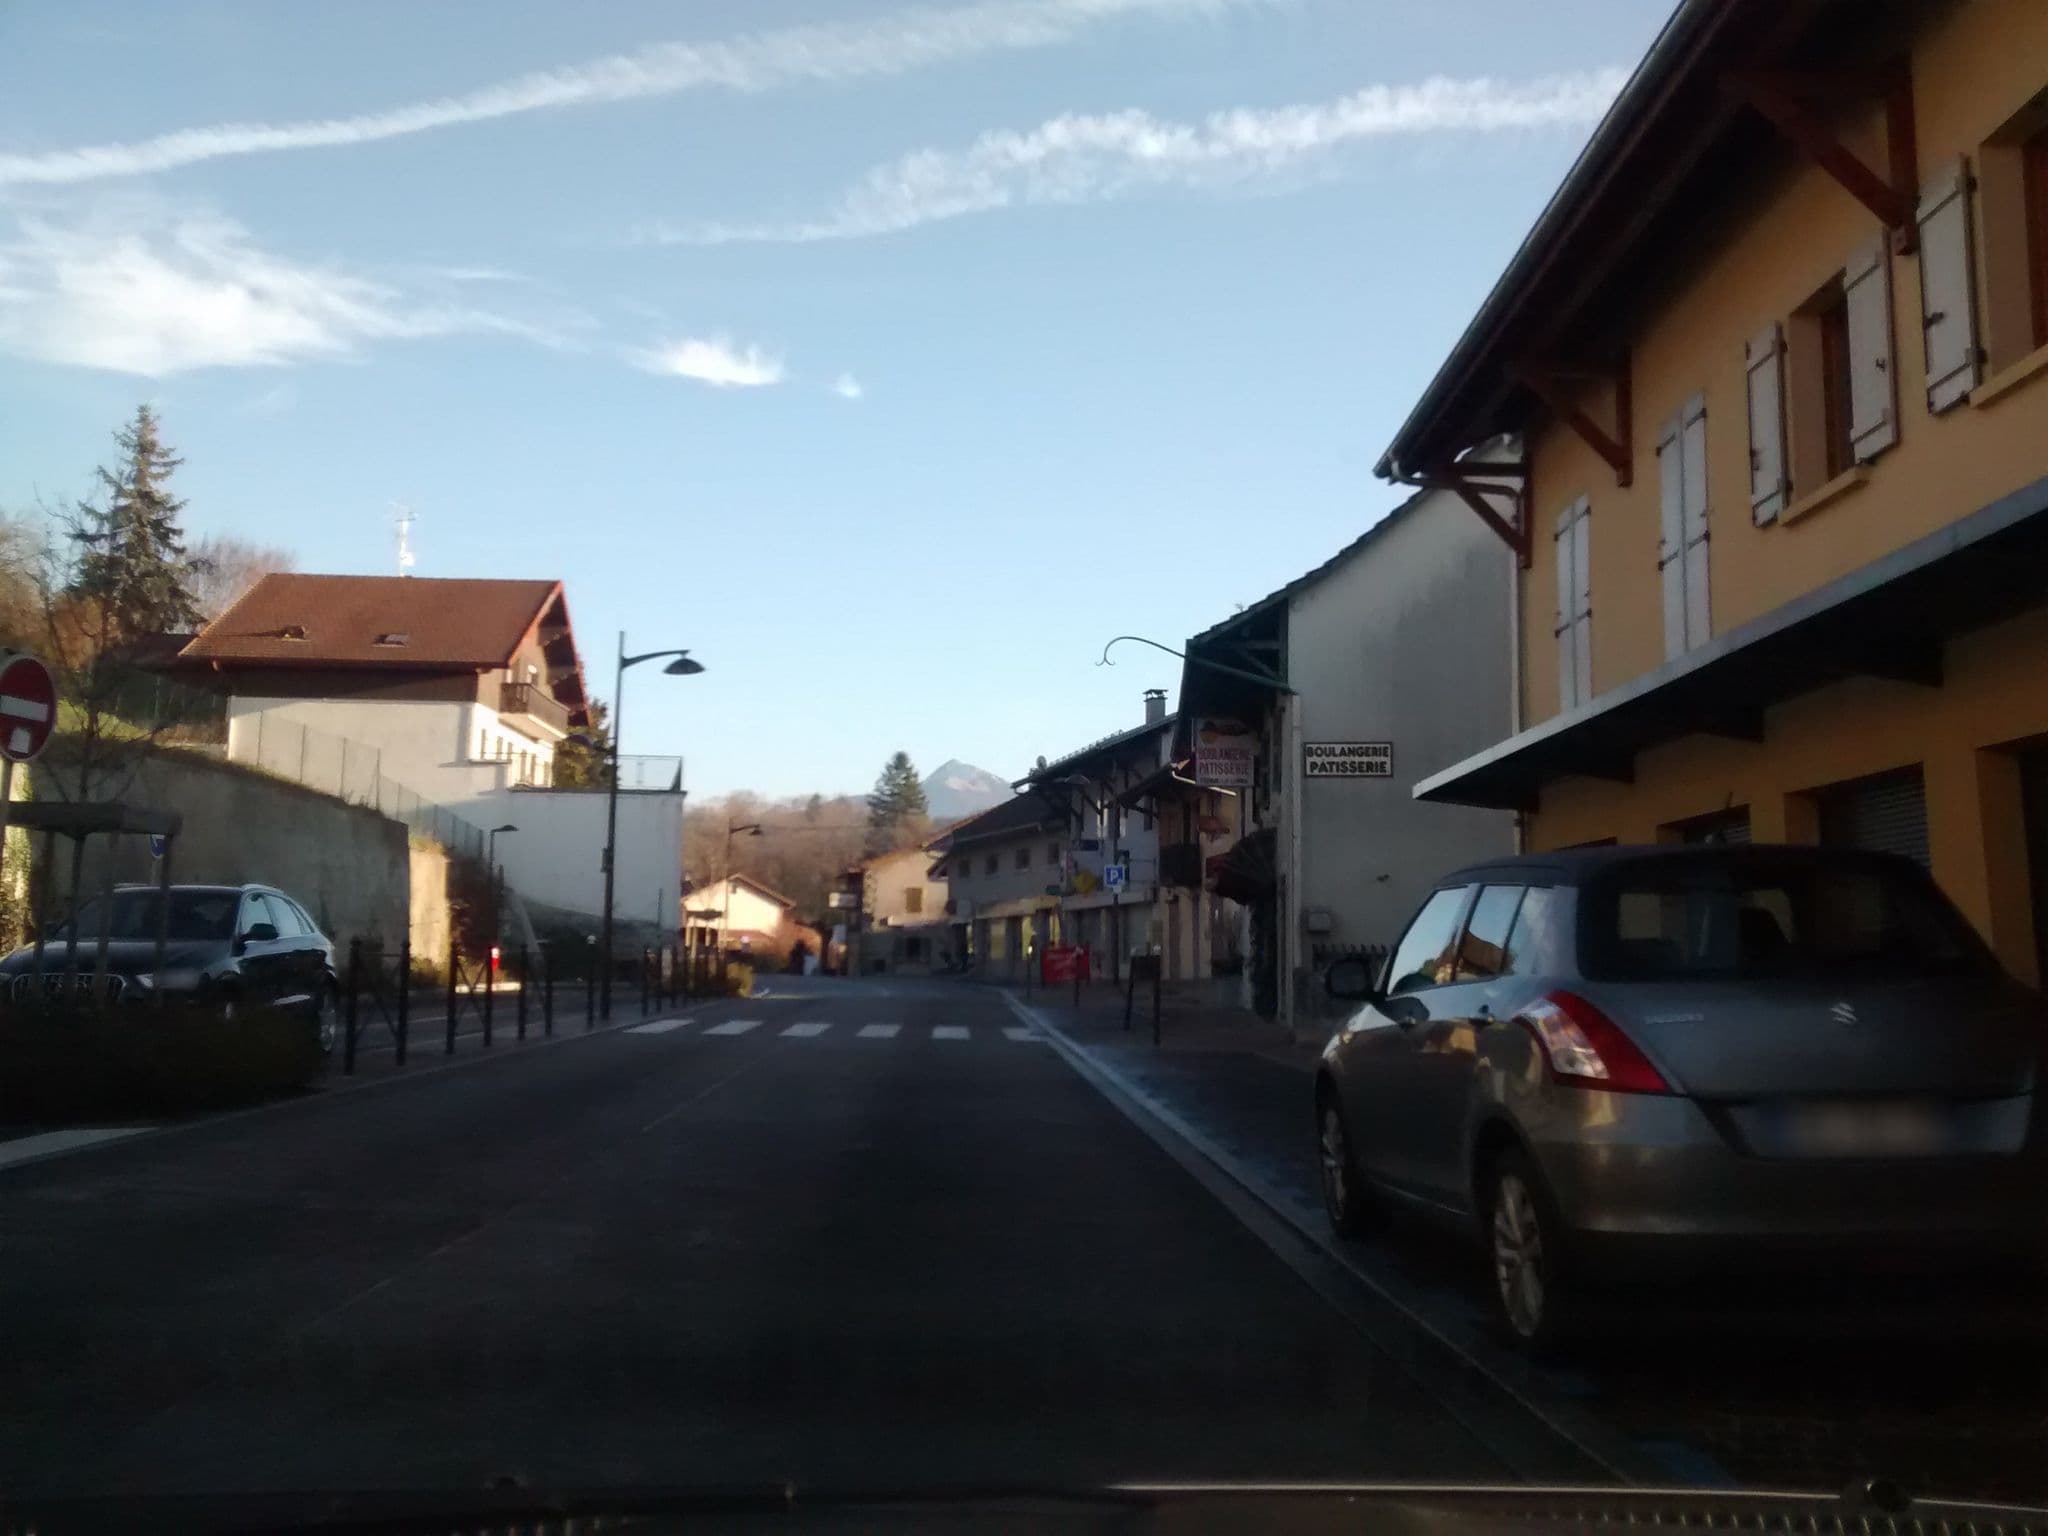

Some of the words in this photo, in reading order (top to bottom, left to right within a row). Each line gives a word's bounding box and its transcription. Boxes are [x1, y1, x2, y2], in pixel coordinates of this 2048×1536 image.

[1306, 746, 1389, 758] BOULANGERIE
[1310, 761, 1387, 775] PATISSERIE
[1110, 870, 1118, 882] P
